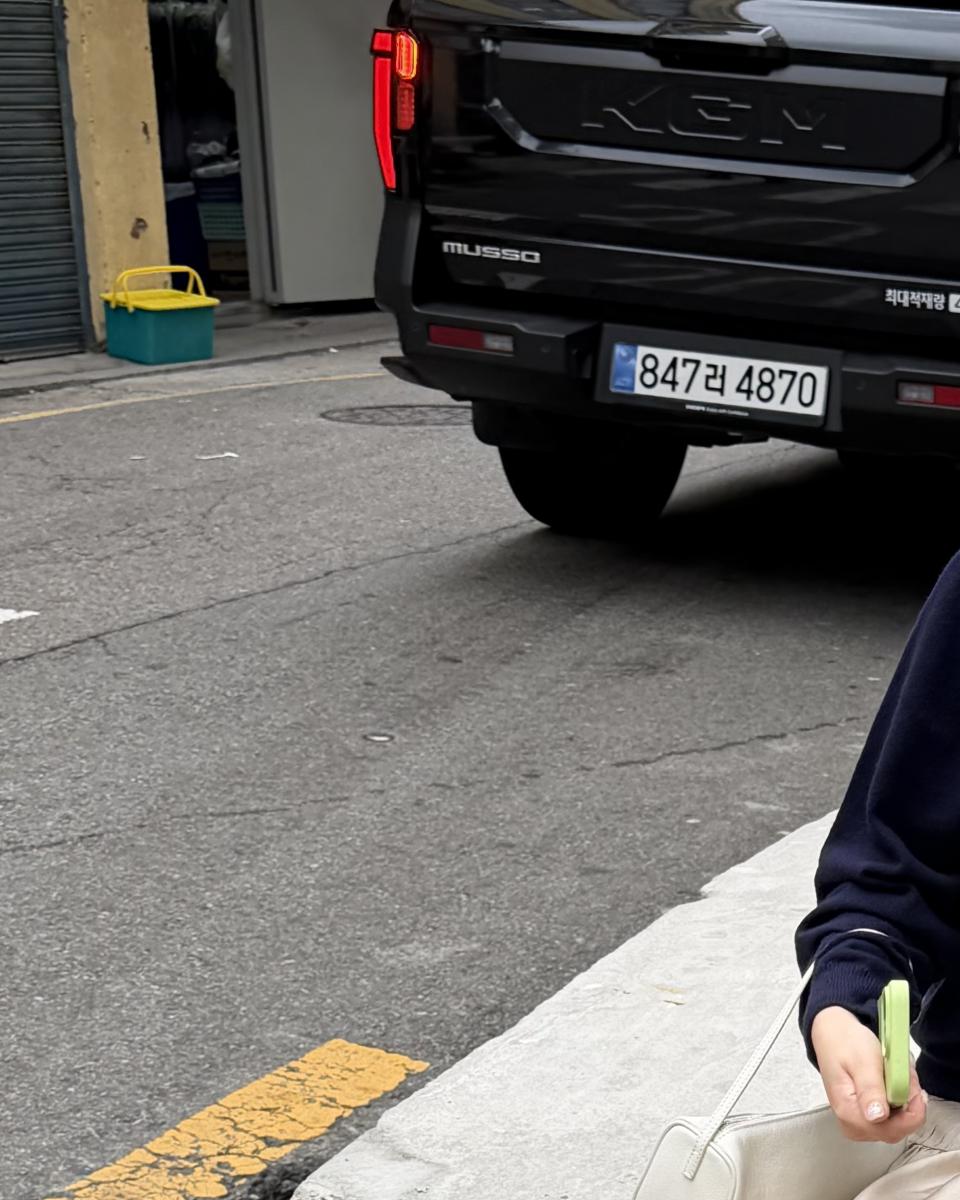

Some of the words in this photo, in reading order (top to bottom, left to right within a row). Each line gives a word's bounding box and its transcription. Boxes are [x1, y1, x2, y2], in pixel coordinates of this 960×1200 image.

[580, 80, 849, 150] KGM
[442, 241, 541, 263] MUSSO
[885, 288, 945, 310] 최대적재량
[638, 353, 727, 397] 847러
[735, 364, 818, 408] 4870
